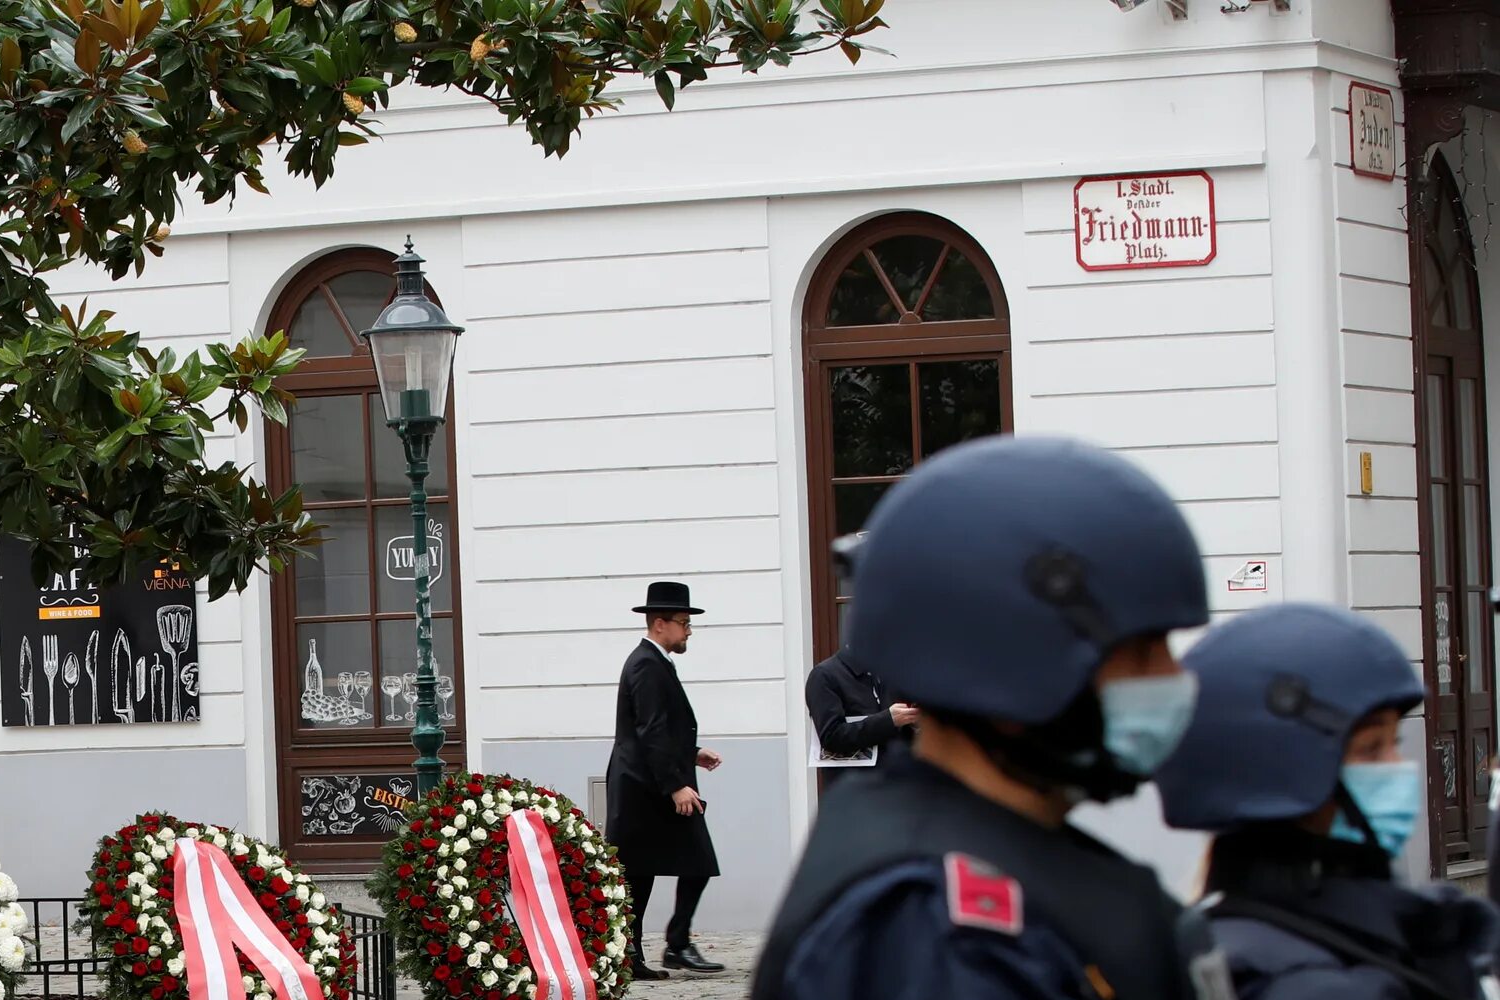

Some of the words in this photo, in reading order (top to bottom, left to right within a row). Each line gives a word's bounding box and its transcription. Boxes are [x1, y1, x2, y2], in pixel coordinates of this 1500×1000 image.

[1081, 207, 1208, 245] Friedmann-
[1124, 242, 1168, 264] Platz.
[143, 578, 192, 591] VIENNA
[49, 609, 66, 617] WINE
[73, 609, 93, 617] FOOD
